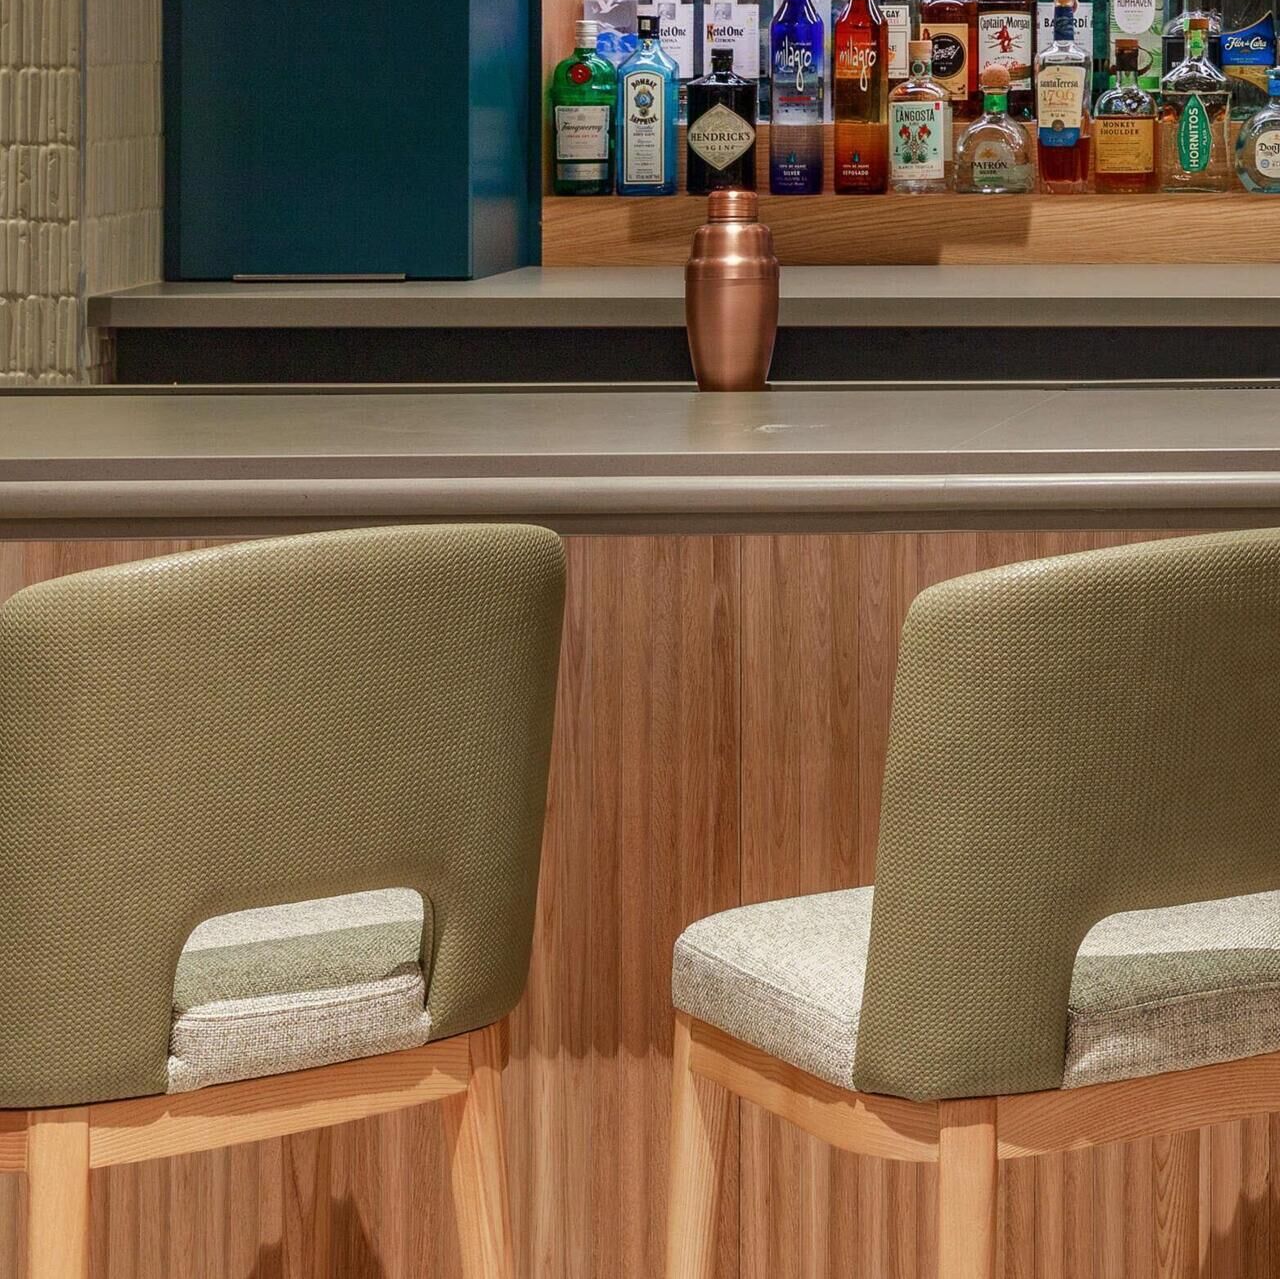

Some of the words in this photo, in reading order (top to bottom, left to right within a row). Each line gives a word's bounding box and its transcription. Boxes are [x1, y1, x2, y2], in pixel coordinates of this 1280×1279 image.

[886, 10, 901, 18] GAY
[980, 16, 1004, 31] Captain
[1044, 15, 1088, 28] BARDÍ
[671, 26, 687, 37] One
[706, 23, 726, 44] Ketel
[726, 26, 744, 37] One
[1224, 36, 1244, 50] Flor
[775, 34, 813, 92] milagro
[839, 34, 878, 92] milagro
[630, 78, 658, 90] BOMBAY
[1100, 128, 1139, 136] SHOULDER
[1189, 107, 1199, 168] HORNITOS
